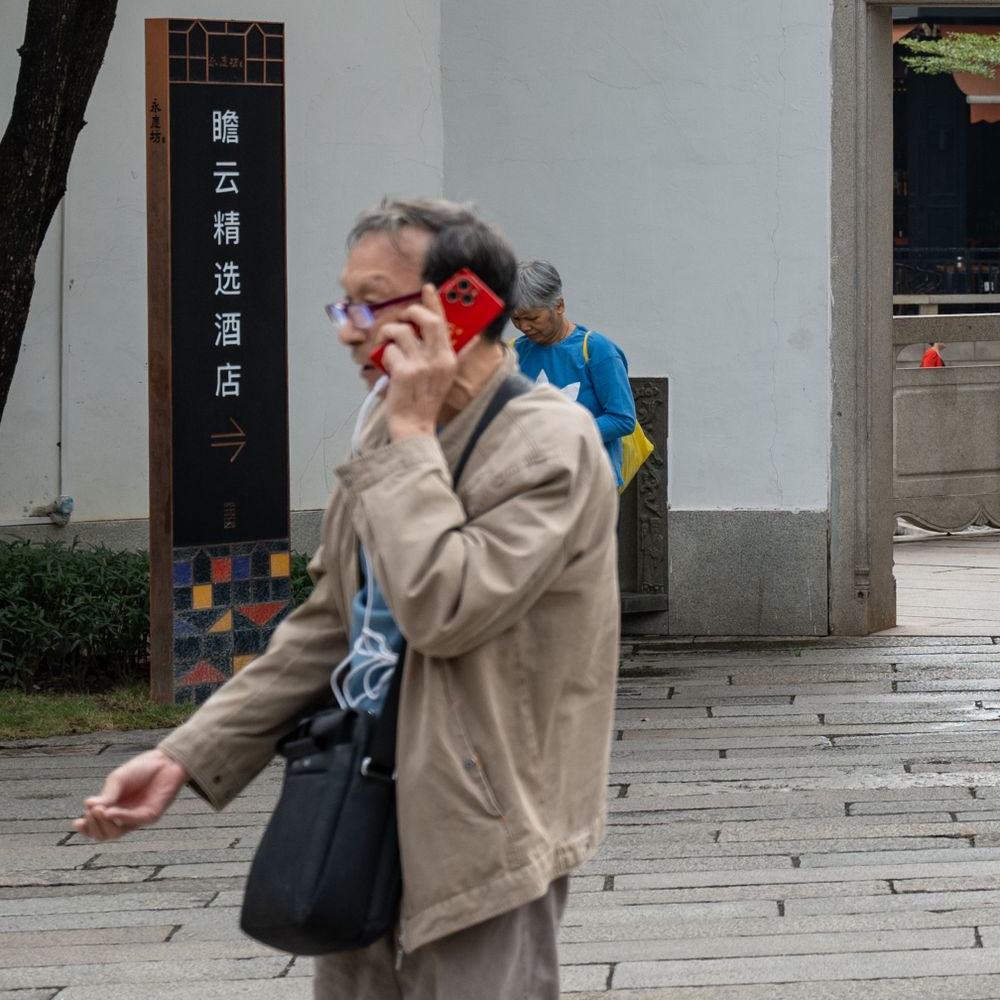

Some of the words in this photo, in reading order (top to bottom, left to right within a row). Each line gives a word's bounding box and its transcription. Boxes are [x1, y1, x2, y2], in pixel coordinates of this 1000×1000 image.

[212, 109, 241, 398] 瞻云精选酒店
